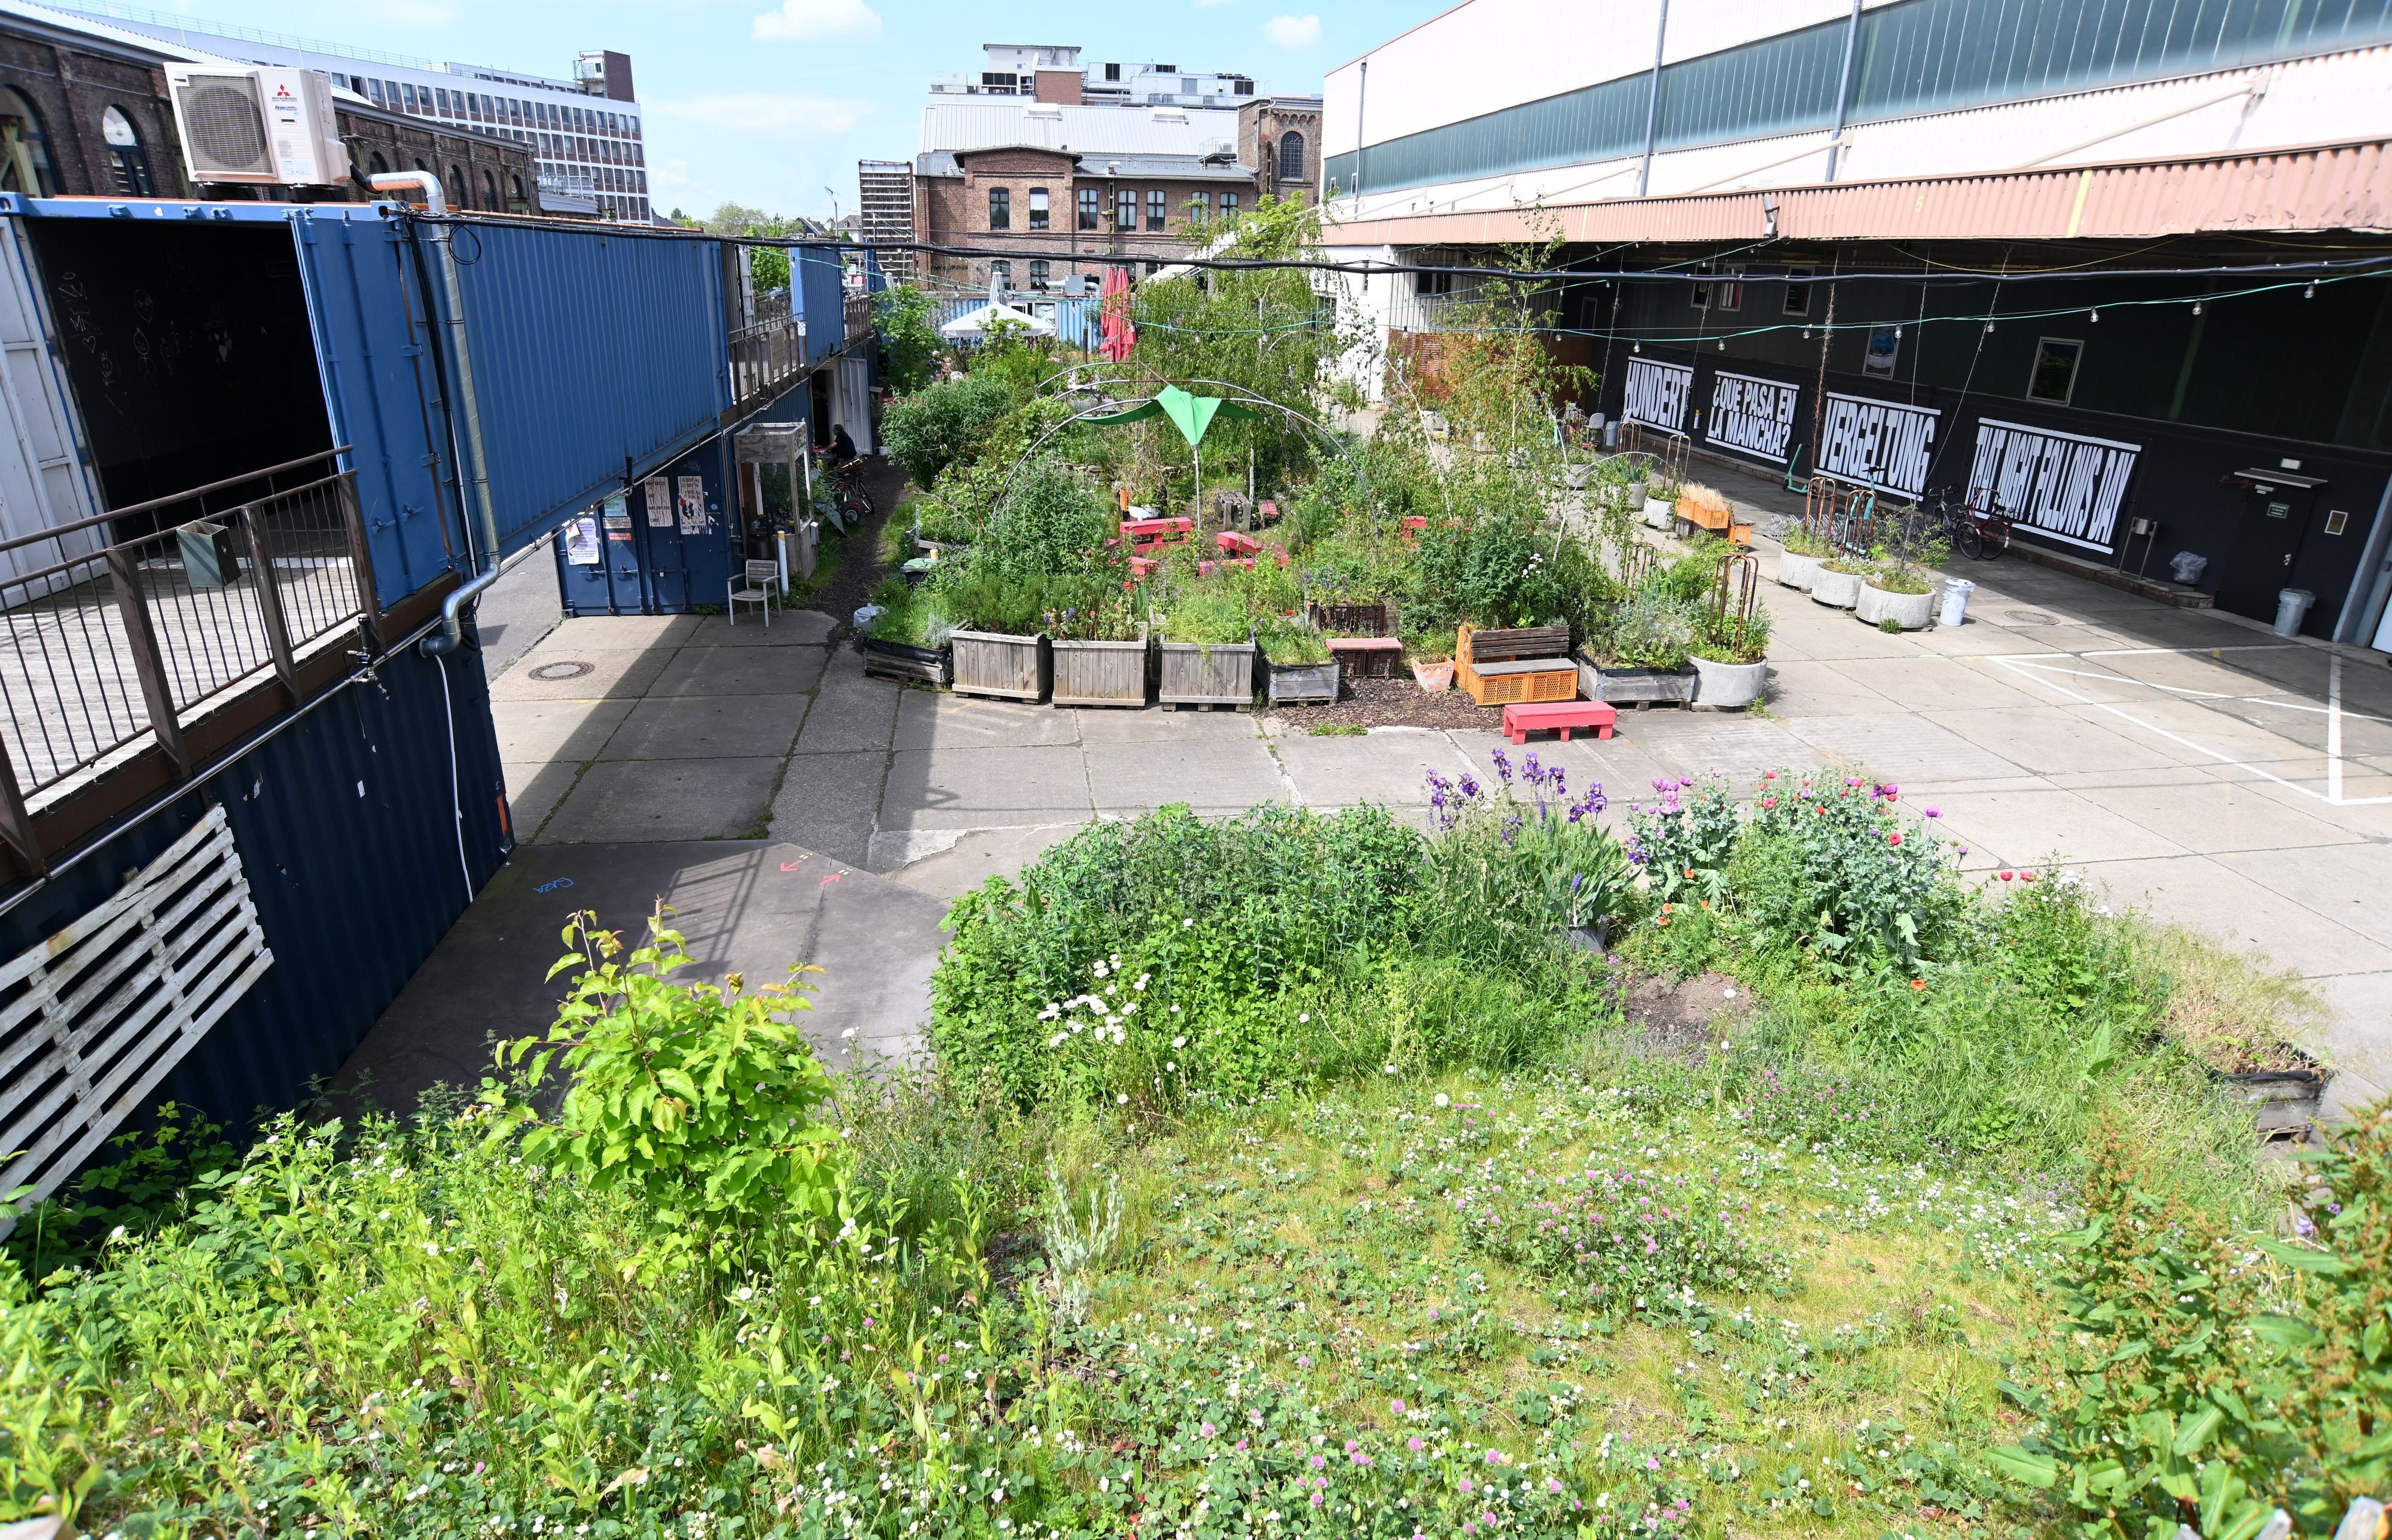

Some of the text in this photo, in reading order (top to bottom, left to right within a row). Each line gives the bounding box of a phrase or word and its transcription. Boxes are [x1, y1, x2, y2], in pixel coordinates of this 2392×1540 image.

[1623, 361, 1693, 430] HUNDERT
[1713, 375, 1796, 424] ¿QUÉ PASA EN
[1707, 407, 1791, 457] LA MANCHA?
[1819, 398, 1935, 493] VERGELTUNG
[1964, 425, 2136, 544] THAT NIGHT FOLLOWS DAY
